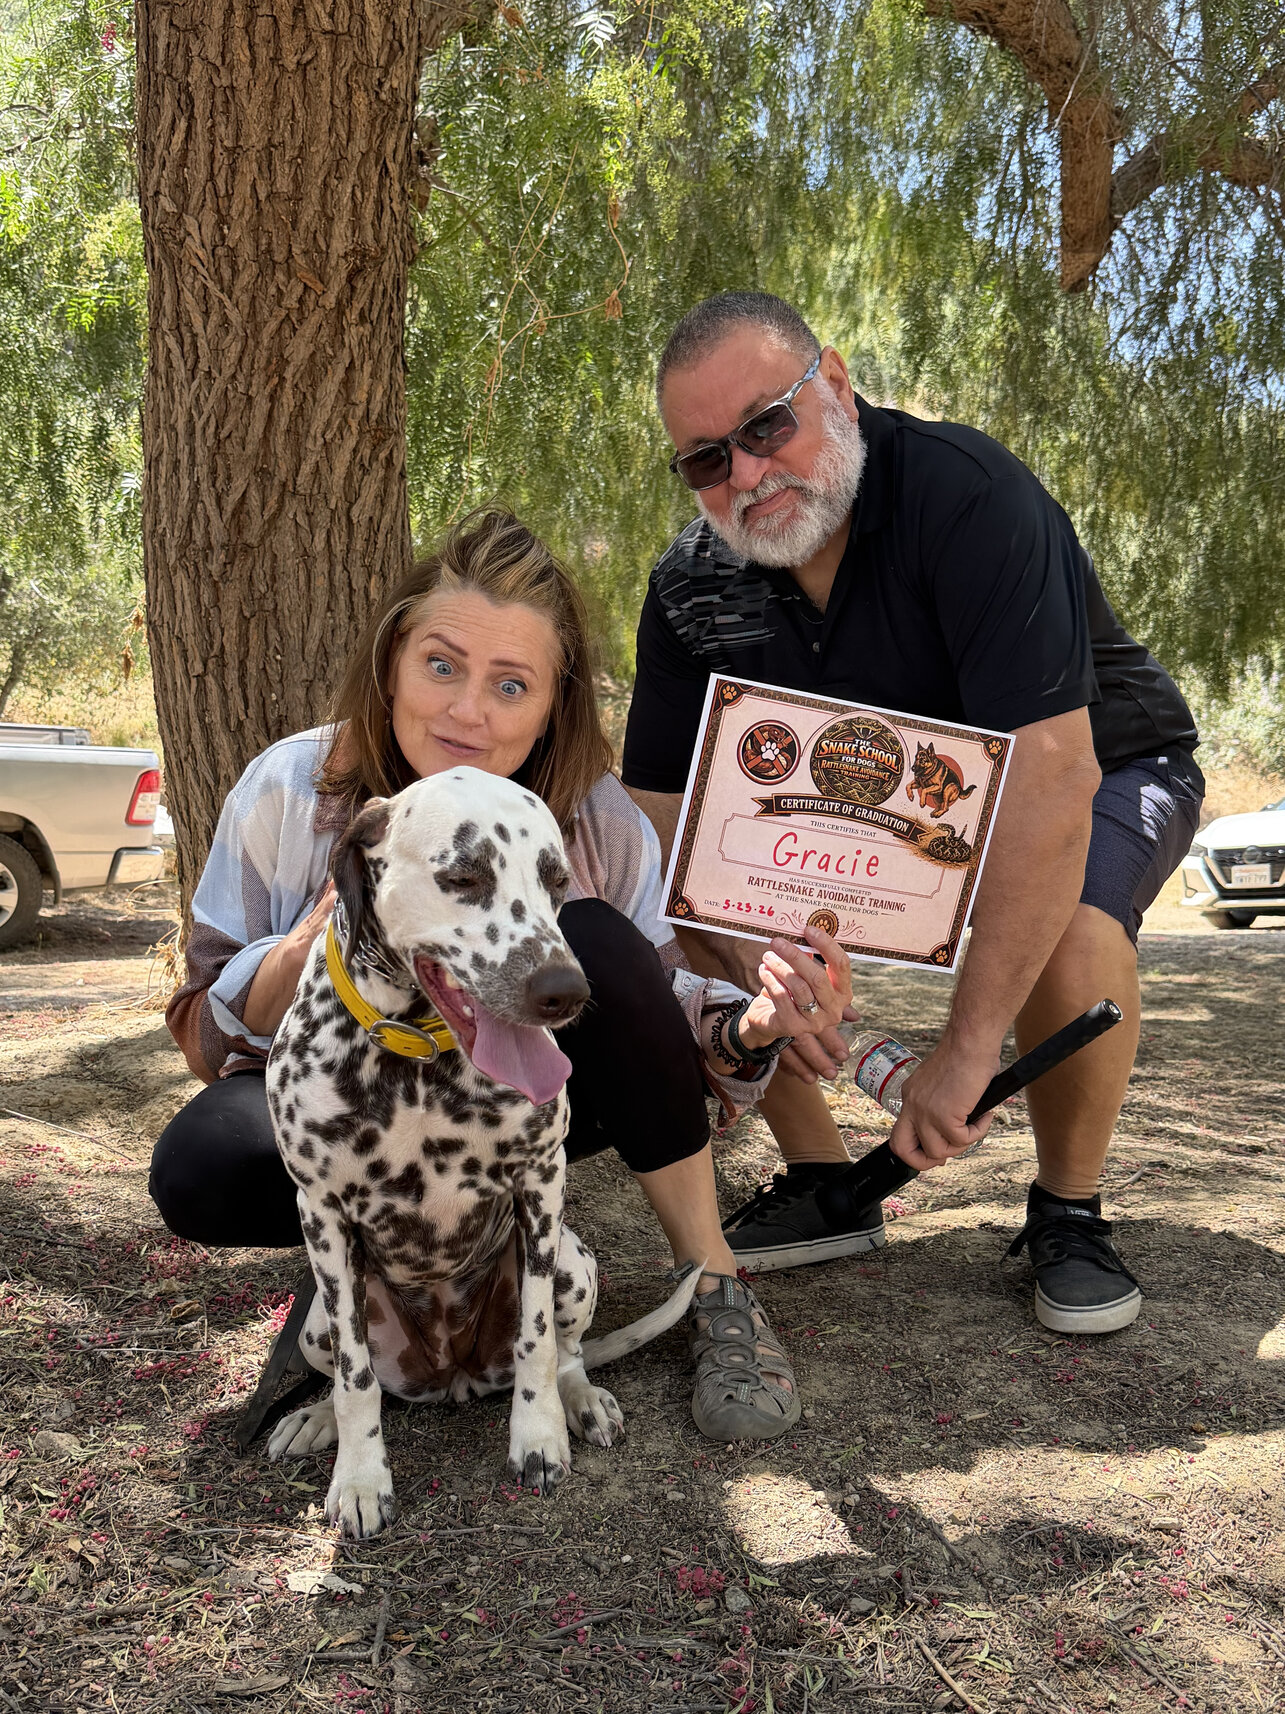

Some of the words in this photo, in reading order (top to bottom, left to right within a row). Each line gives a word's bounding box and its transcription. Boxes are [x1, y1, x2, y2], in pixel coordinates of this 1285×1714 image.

[854, 738, 871, 747] THE
[820, 740, 858, 755] SNAKE
[857, 745, 898, 770] SCHOOL
[841, 756, 857, 765] FOR
[857, 758, 876, 768] DOGS
[821, 759, 860, 773] RATTLESNAKE
[860, 767, 891, 781] AVOIDANCE
[840, 770, 870, 780] TRAINING
[780, 798, 840, 813] CERTIFICATE
[842, 804, 855, 815] OF
[855, 807, 910, 833] GRADUATION
[810, 820, 826, 828] THIS
[826, 823, 859, 834] CERTIFIES
[860, 829, 877, 838] THAT
[773, 831, 880, 877] Gracie
[747, 875, 815, 897] RATTLESNAKE
[816, 889, 866, 906] AVOIDANCE
[868, 897, 906, 912] TRAINING
[801, 879, 841, 891] SUCCESSFULLY
[841, 886, 872, 896] COMPLETED
[704, 899, 720, 907] DATE:
[800, 897, 822, 907] SNAKE
[822, 901, 848, 911] SCHOOL
[862, 908, 879, 916] DOGS
